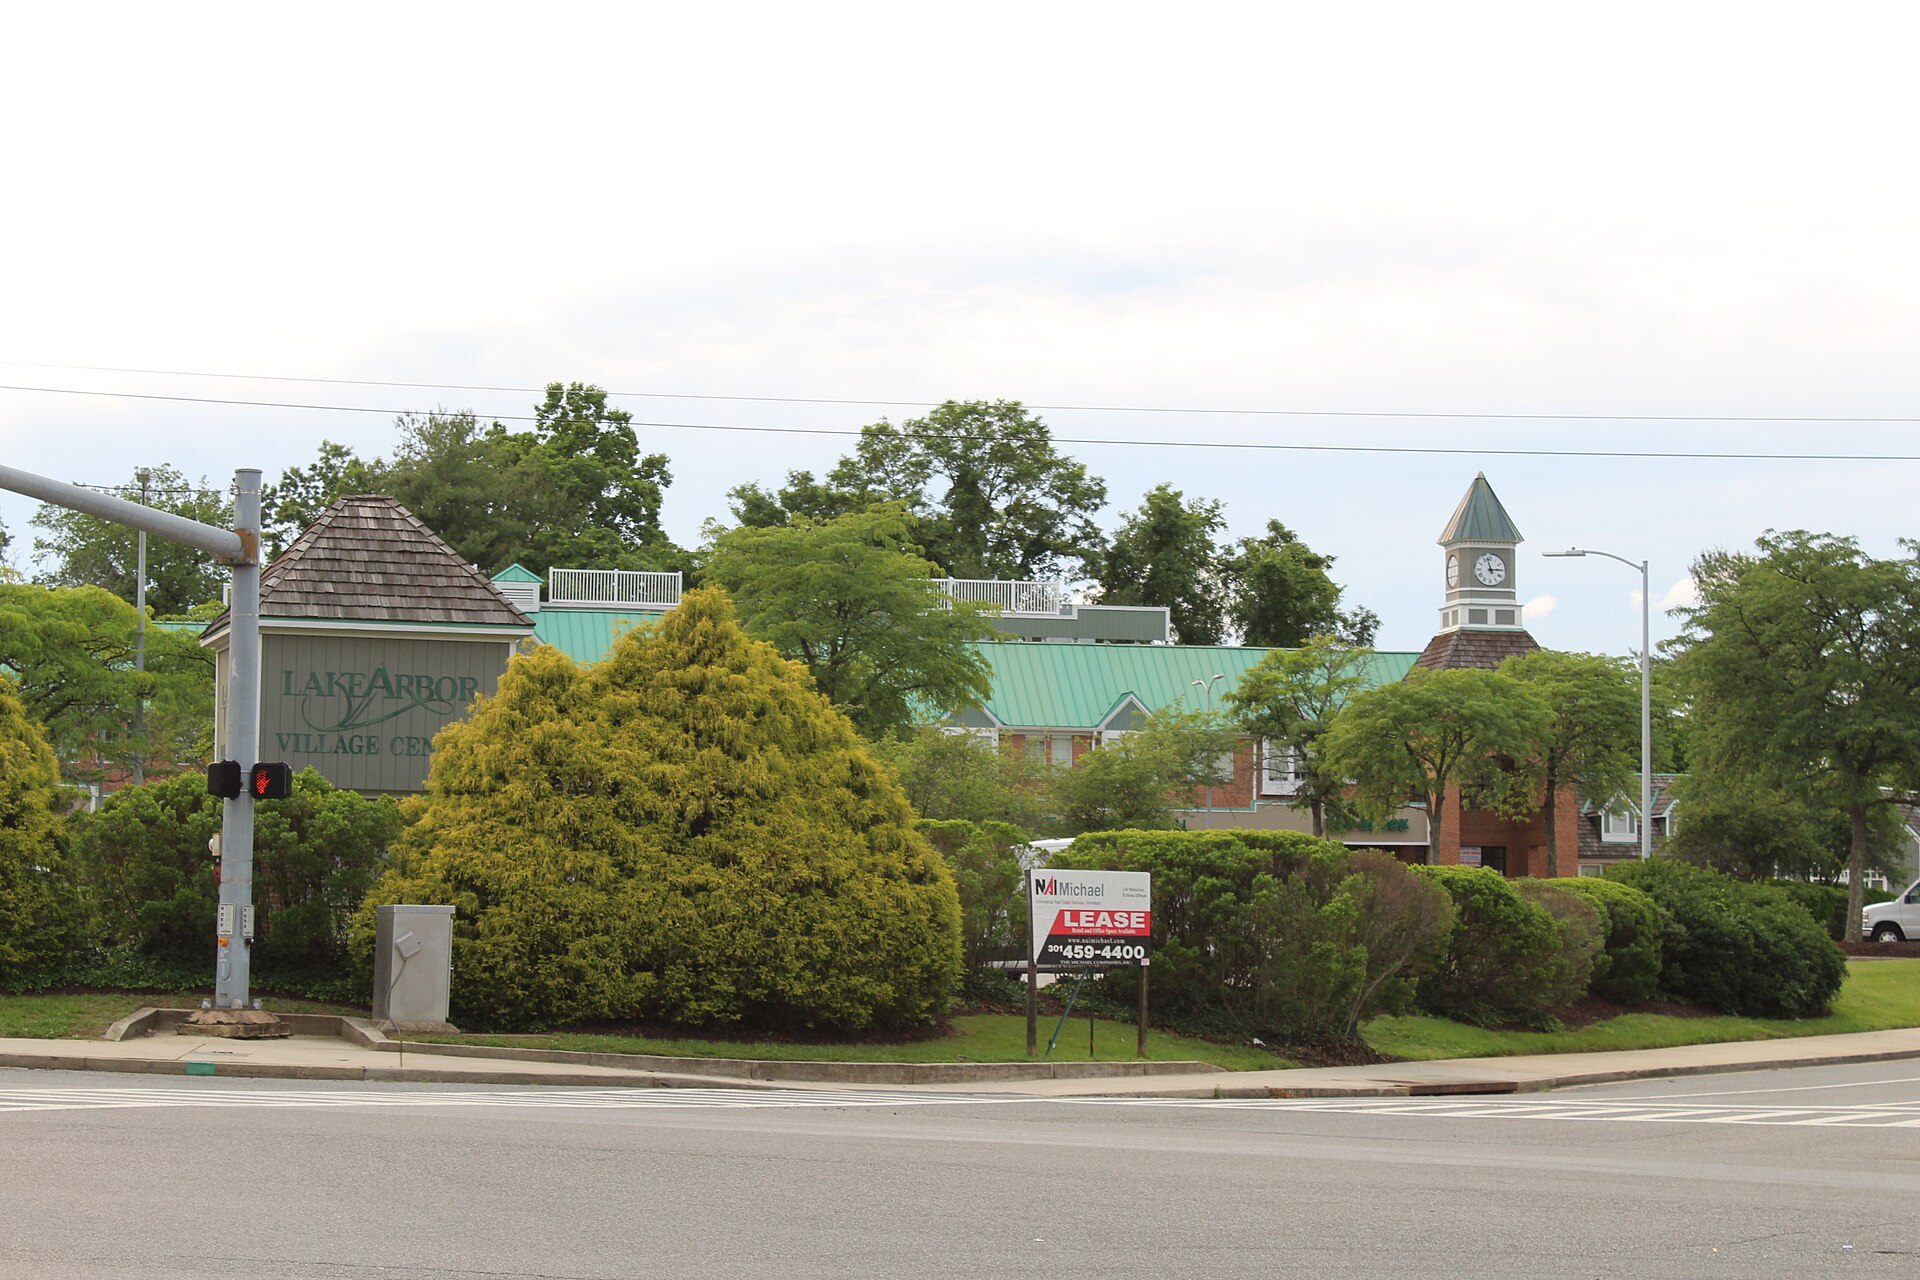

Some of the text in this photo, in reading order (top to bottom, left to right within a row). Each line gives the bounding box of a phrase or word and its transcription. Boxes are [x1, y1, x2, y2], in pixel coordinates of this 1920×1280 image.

[283, 665, 479, 701] LAKE ARBOR
[275, 732, 434, 757] VILLAGE CEN
[1035, 876, 1104, 897] NAI Michael
[1064, 911, 1145, 928] LEASE
[1047, 945, 1145, 959] 301 459-4400
